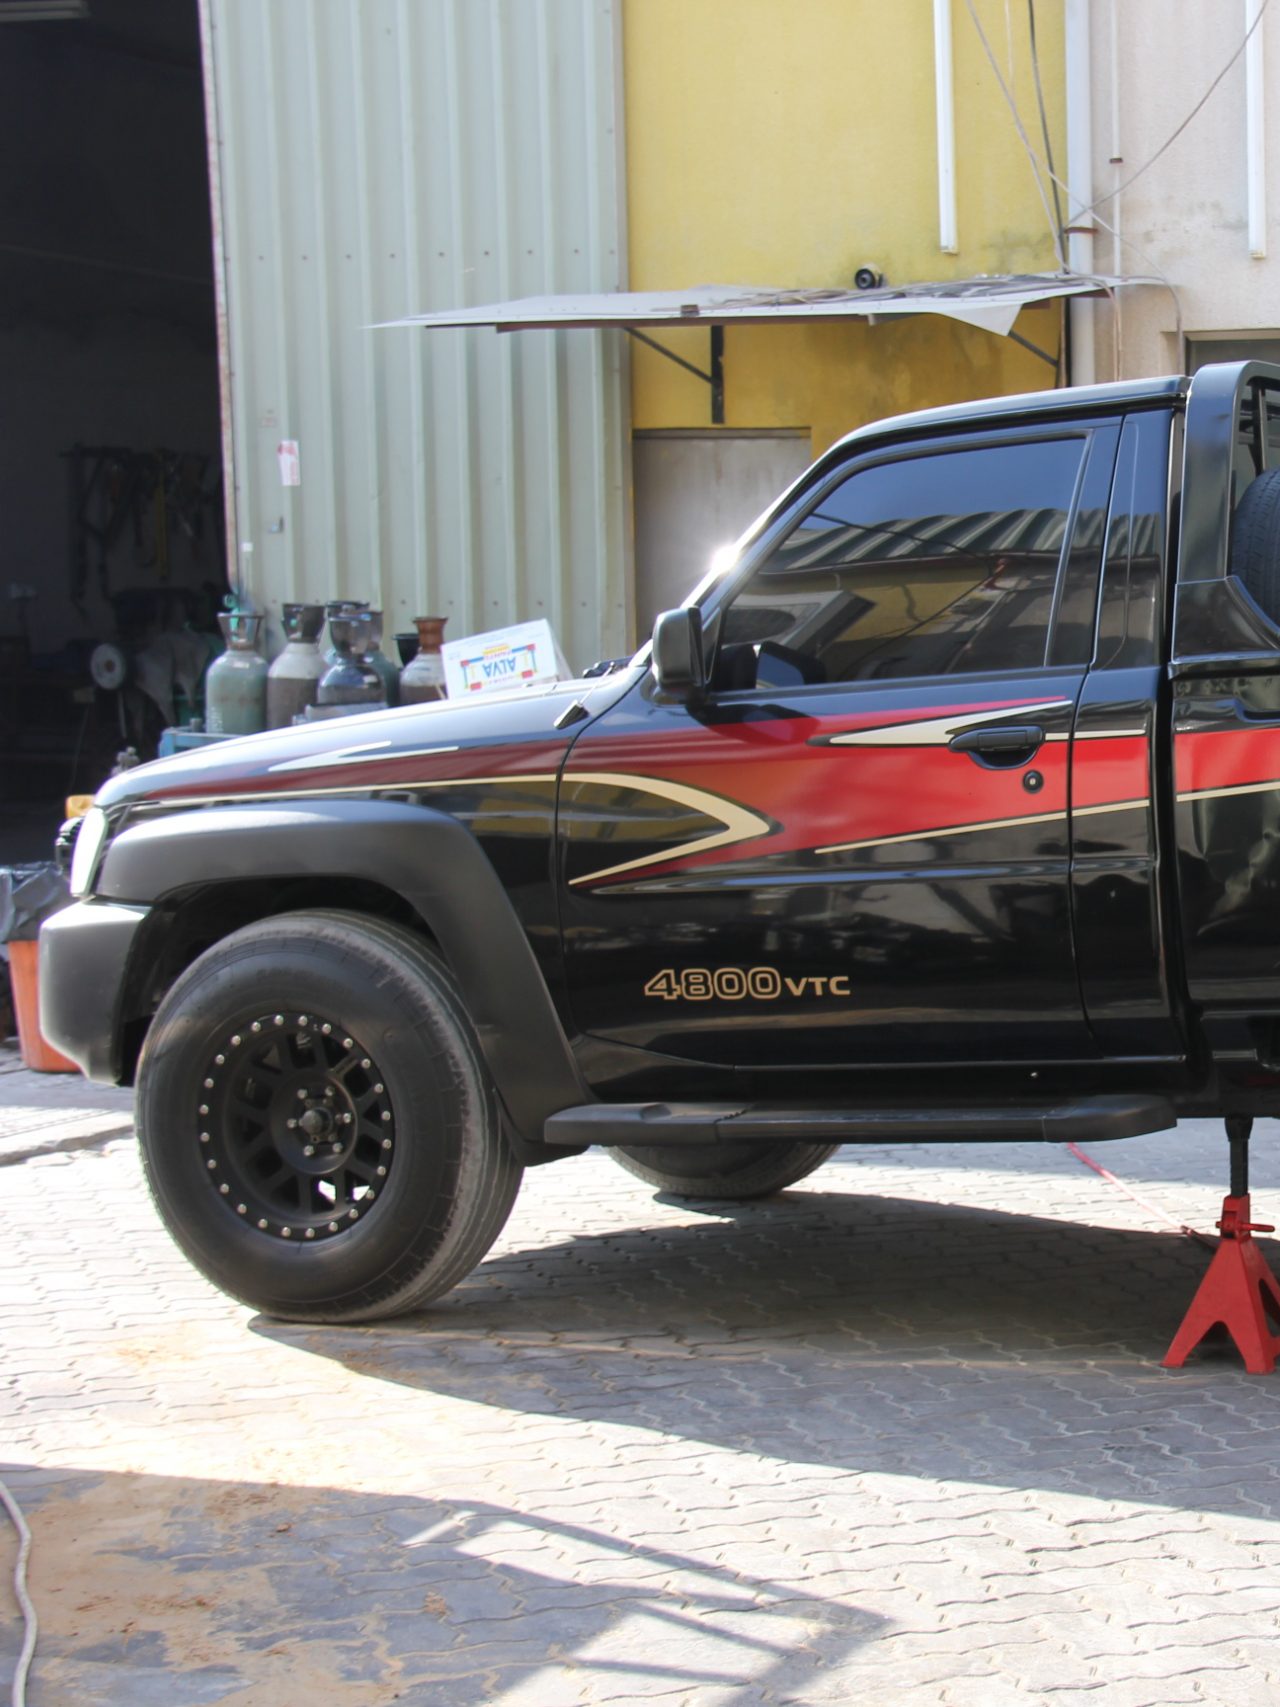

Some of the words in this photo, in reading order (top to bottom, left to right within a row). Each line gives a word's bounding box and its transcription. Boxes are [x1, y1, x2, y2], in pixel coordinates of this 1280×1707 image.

[482, 657, 516, 677] ALVA
[644, 966, 782, 1000] 4800
[785, 976, 851, 997] VTC
